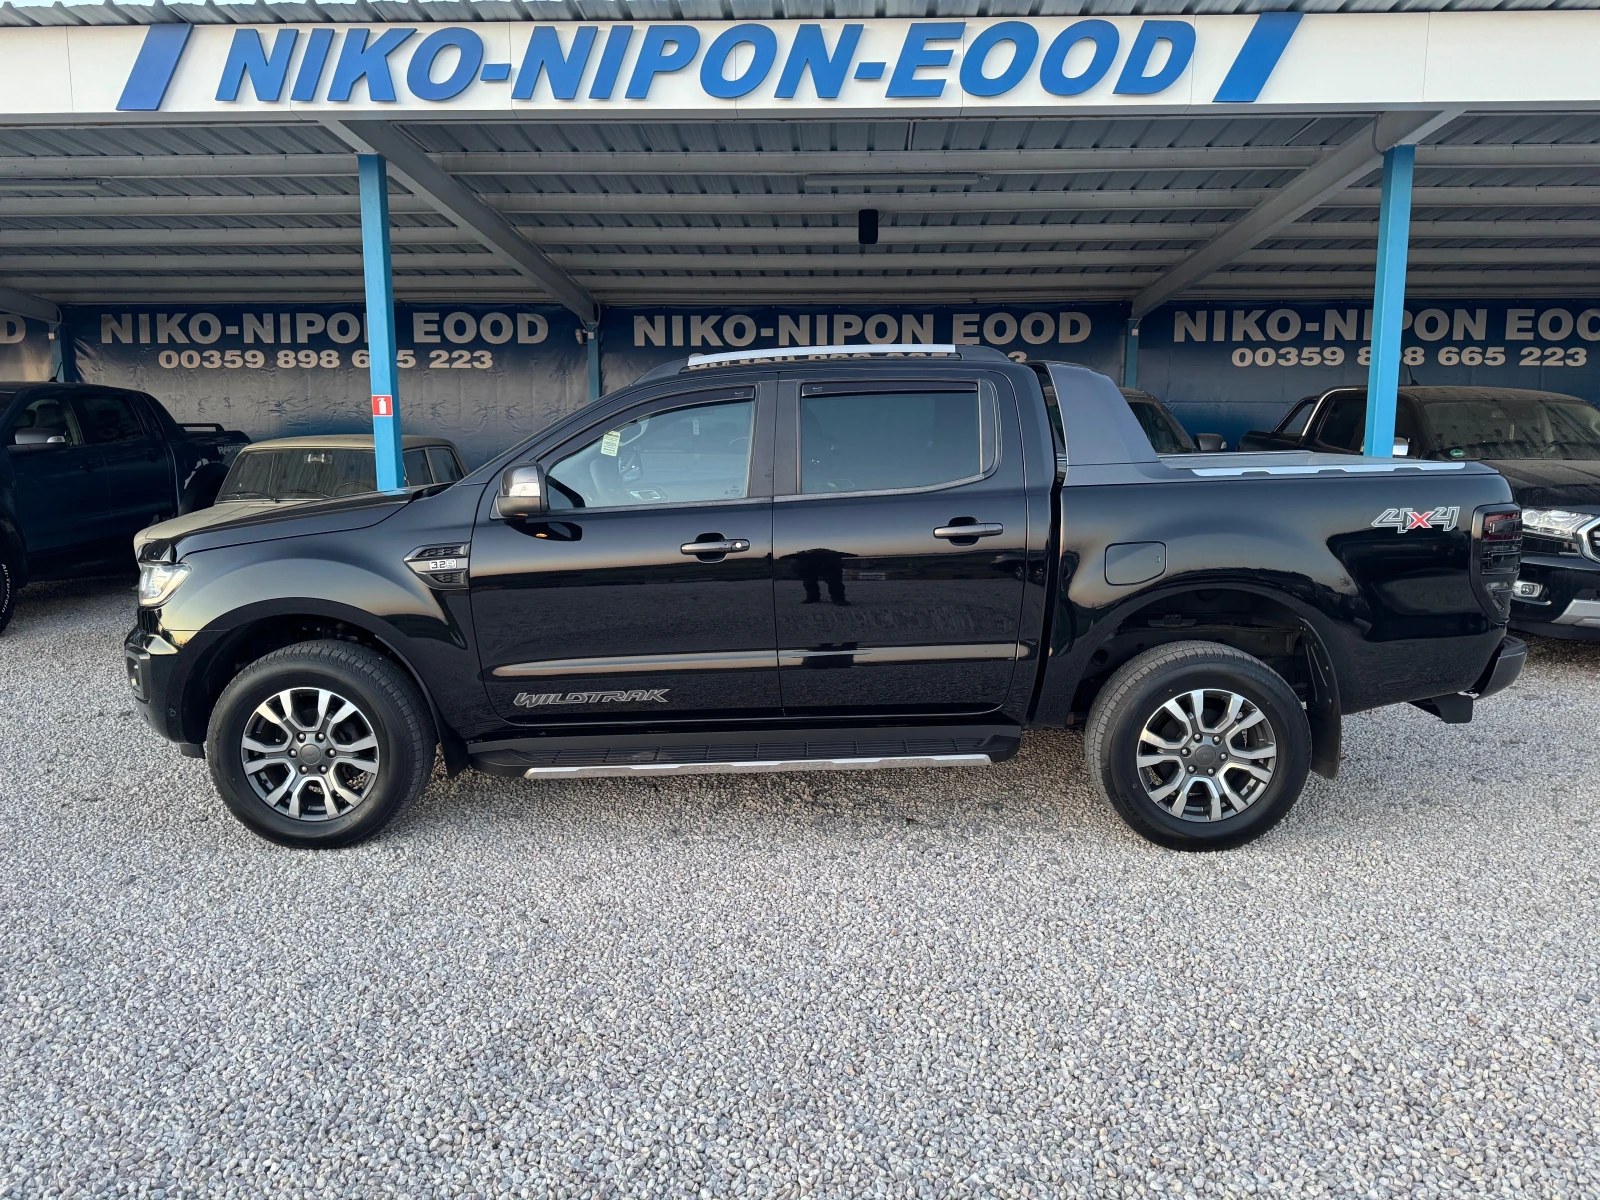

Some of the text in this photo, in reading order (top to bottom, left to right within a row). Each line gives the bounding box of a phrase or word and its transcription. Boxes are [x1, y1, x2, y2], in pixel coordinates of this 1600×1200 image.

[215, 19, 1196, 102] NIKO-NIPON-EOOD
[100, 312, 549, 344] NIKO-NIPO EOOD
[633, 311, 1093, 347] NIKO-NIPON EOOD
[1173, 308, 1488, 342] NIKO-NION
[158, 349, 494, 369] 00359 898 65 223
[1231, 346, 1587, 367] 00359 88 665 223
[217, 445, 245, 456] RAPTO
[513, 688, 671, 708] WILDTRAK
